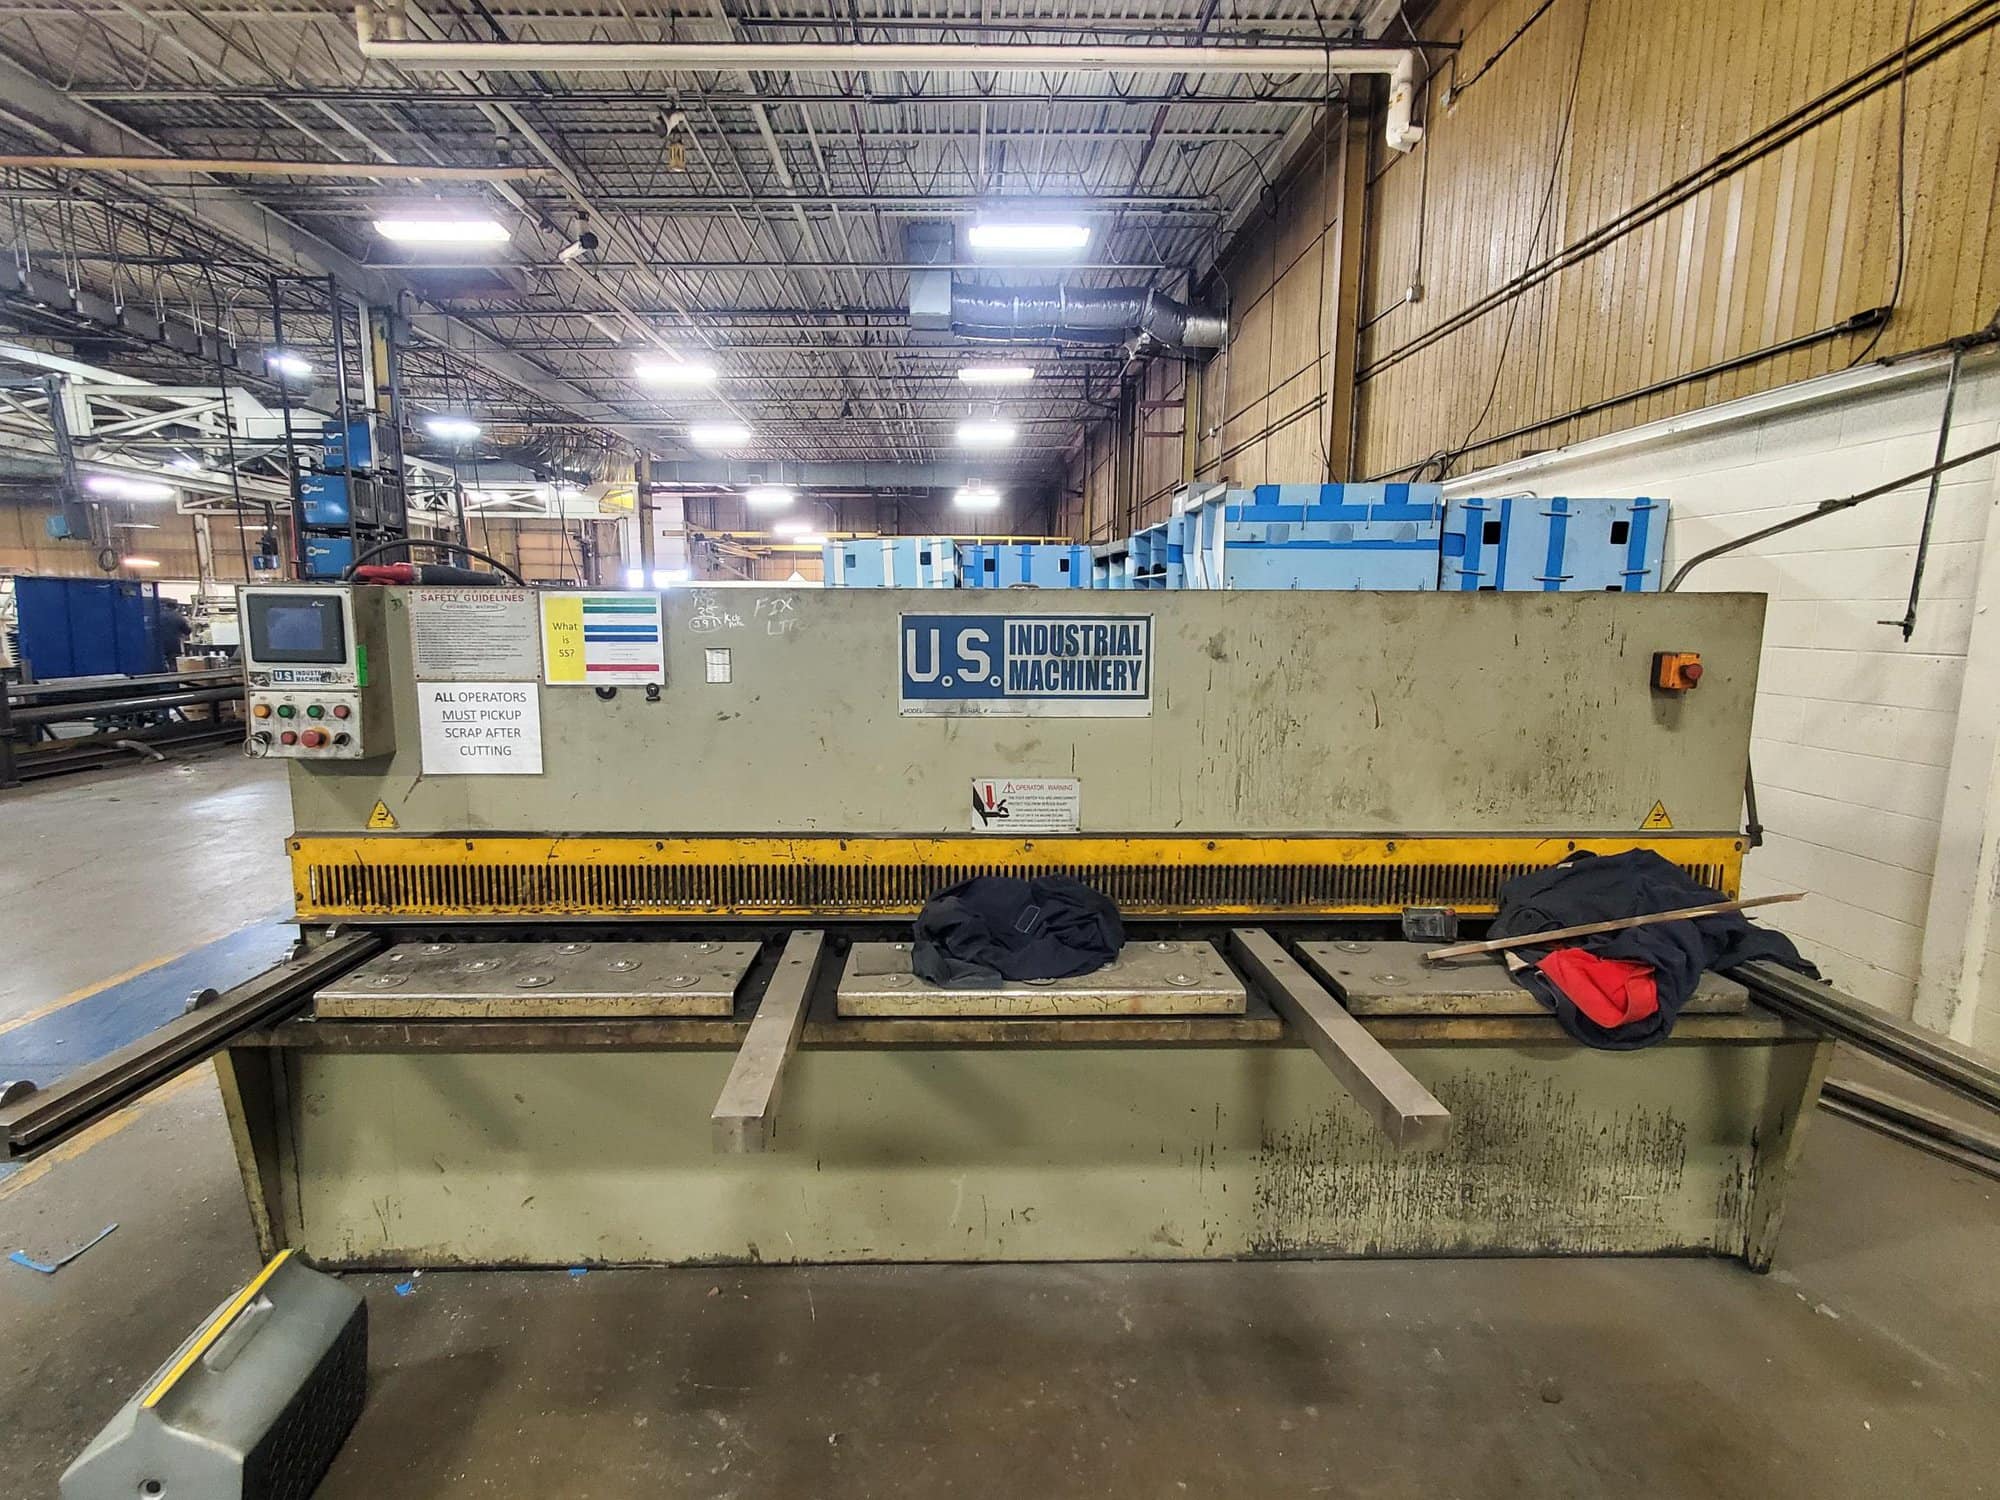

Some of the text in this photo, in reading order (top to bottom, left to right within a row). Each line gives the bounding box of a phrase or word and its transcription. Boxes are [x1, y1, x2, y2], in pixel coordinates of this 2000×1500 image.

[420, 594, 525, 602] SAFETY GUIDELINES
[753, 597, 793, 616] FIX
[552, 622, 578, 631] What
[562, 635, 570, 644] is
[1009, 624, 1142, 656] INDUSTRIAL
[905, 627, 1003, 688] U.S.
[1008, 659, 1142, 691] MACHINERY
[434, 692, 527, 703] ALL OPERATORS
[442, 710, 522, 721] MUST PICKUP
[445, 728, 521, 738] SCRAP AFTER
[460, 745, 512, 756] CUTTING
